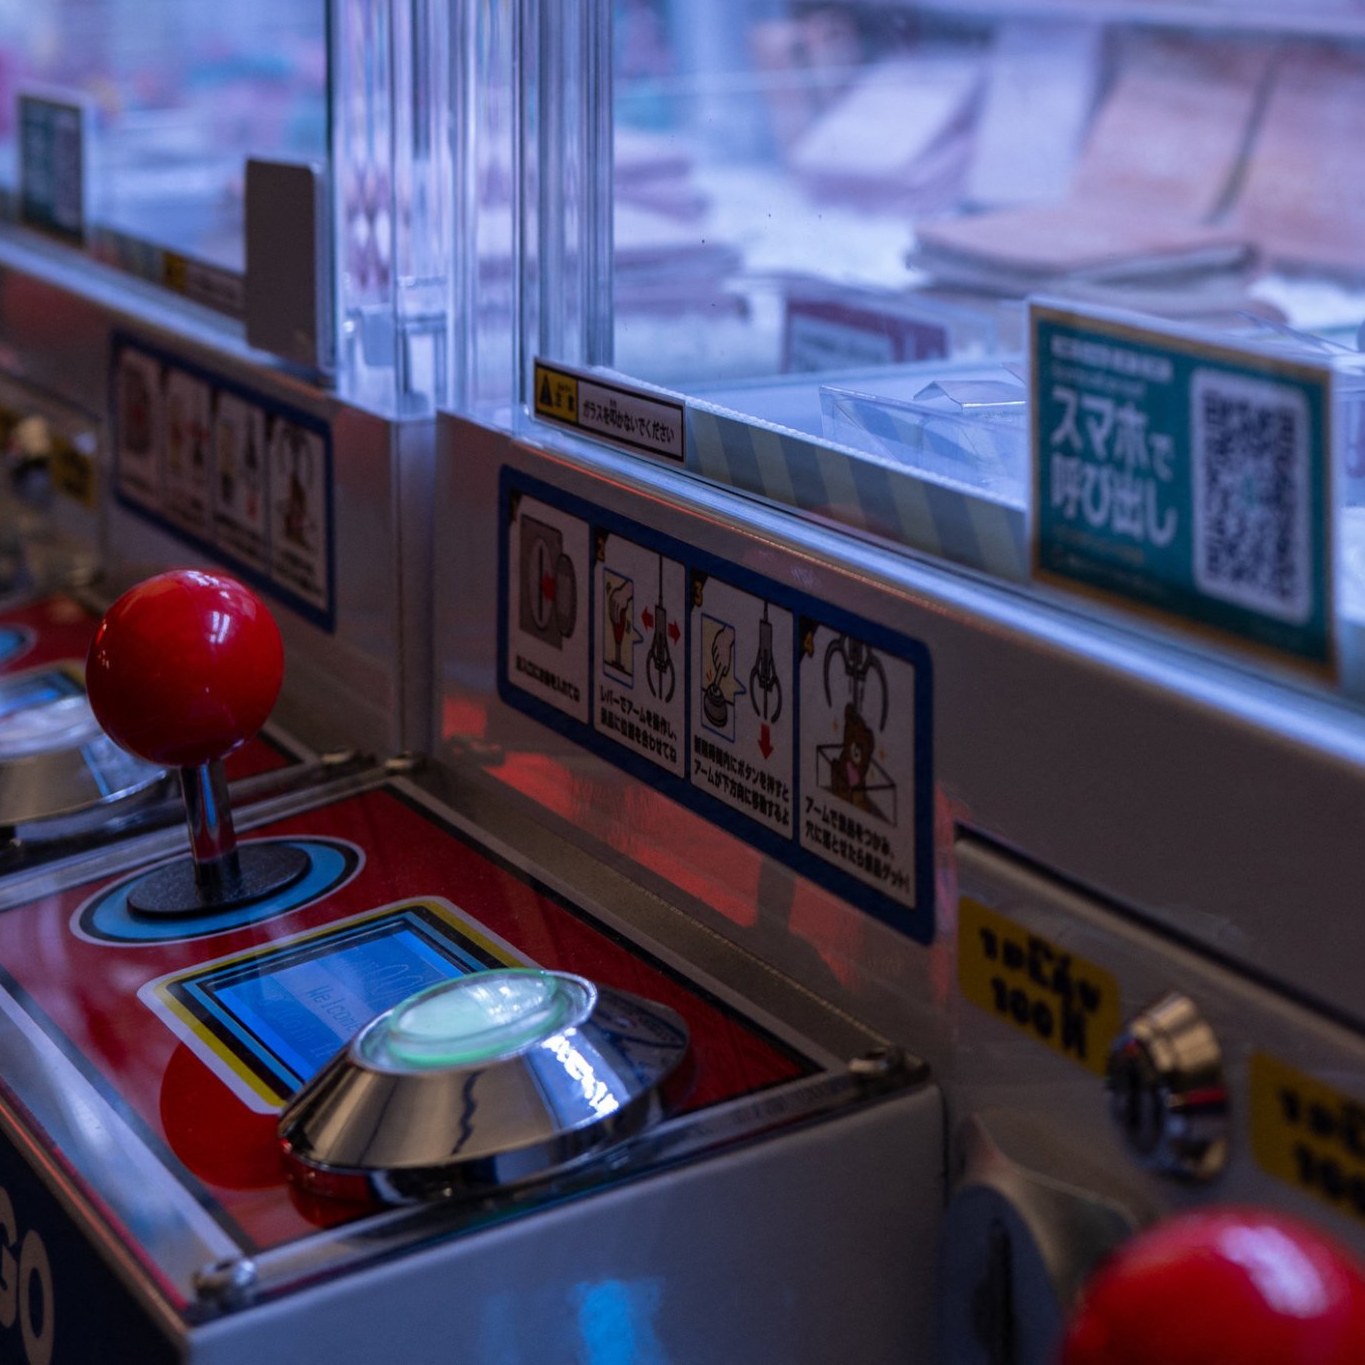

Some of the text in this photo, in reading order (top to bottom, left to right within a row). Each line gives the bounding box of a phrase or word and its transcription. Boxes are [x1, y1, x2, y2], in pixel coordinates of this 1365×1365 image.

[1049, 385, 1176, 483] スマホで
[1049, 453, 1179, 547] 呼び出し
[597, 537, 606, 561] 2
[692, 578, 703, 606] 3
[802, 631, 814, 657] 4
